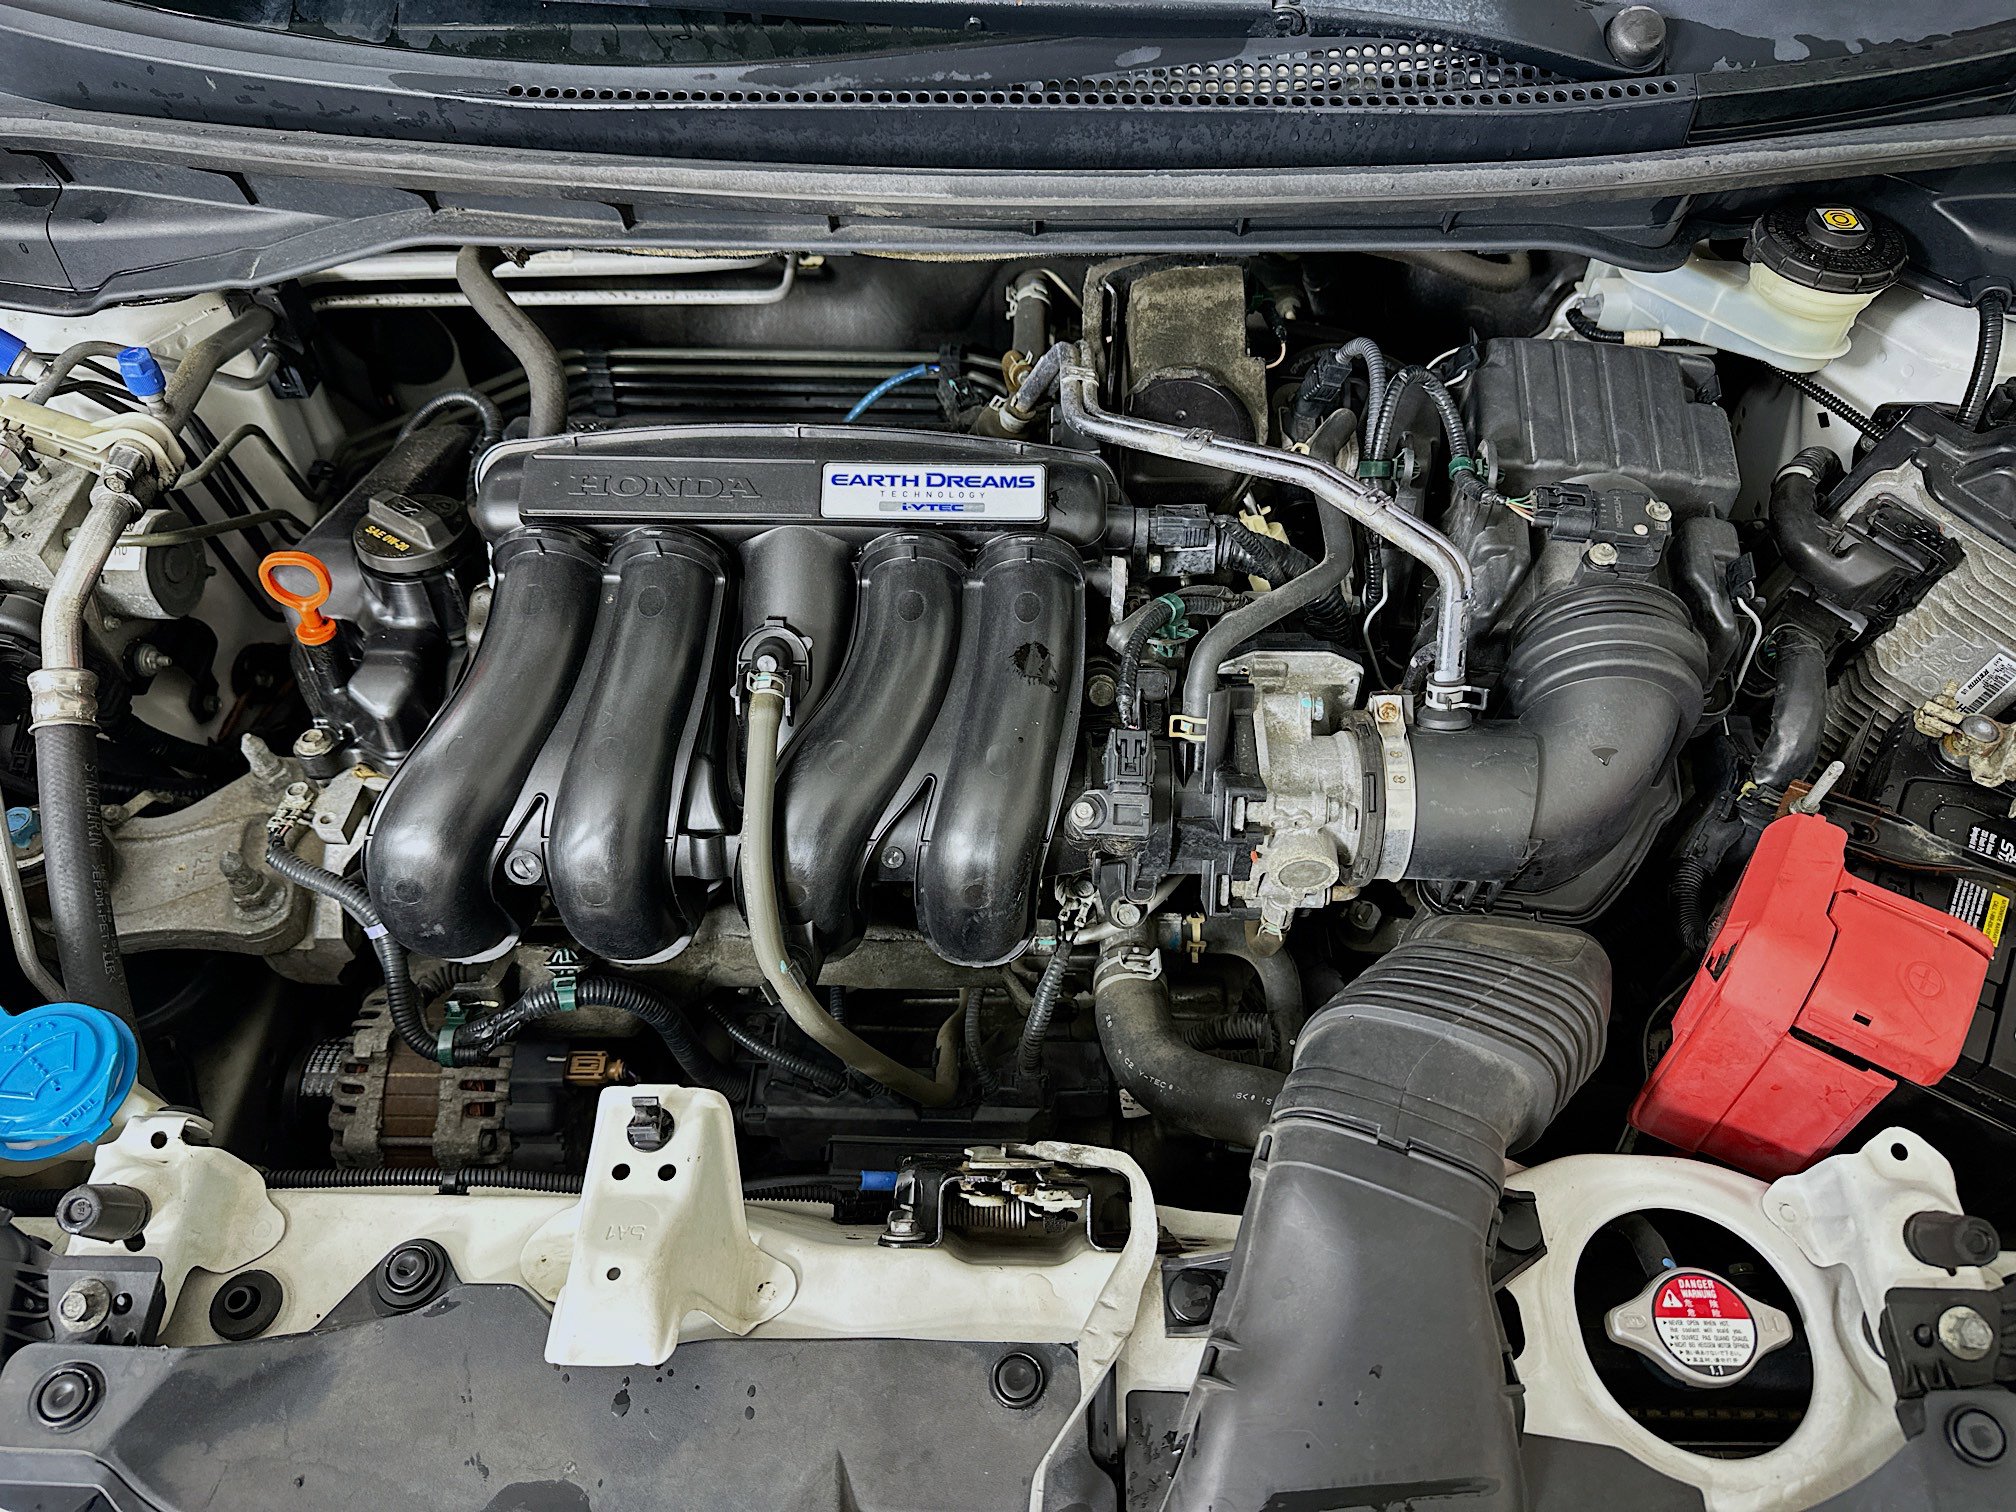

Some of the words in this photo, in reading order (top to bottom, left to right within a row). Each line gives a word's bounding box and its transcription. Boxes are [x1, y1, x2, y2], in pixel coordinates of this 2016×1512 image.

[831, 473, 919, 488] EARTH
[926, 472, 1036, 489] DREAMS
[567, 474, 763, 499] HONDA
[880, 490, 986, 499] TECHNOLOGY
[902, 502, 965, 513] i-VTEC
[365, 525, 387, 539] SAE
[382, 534, 410, 552] 0W-20
[60, 1097, 98, 1128] PULL
[1678, 1279, 1715, 1289] DANGER
[1680, 1289, 1717, 1299] WARNUNG
[1709, 1365, 1724, 1376] 1.1
